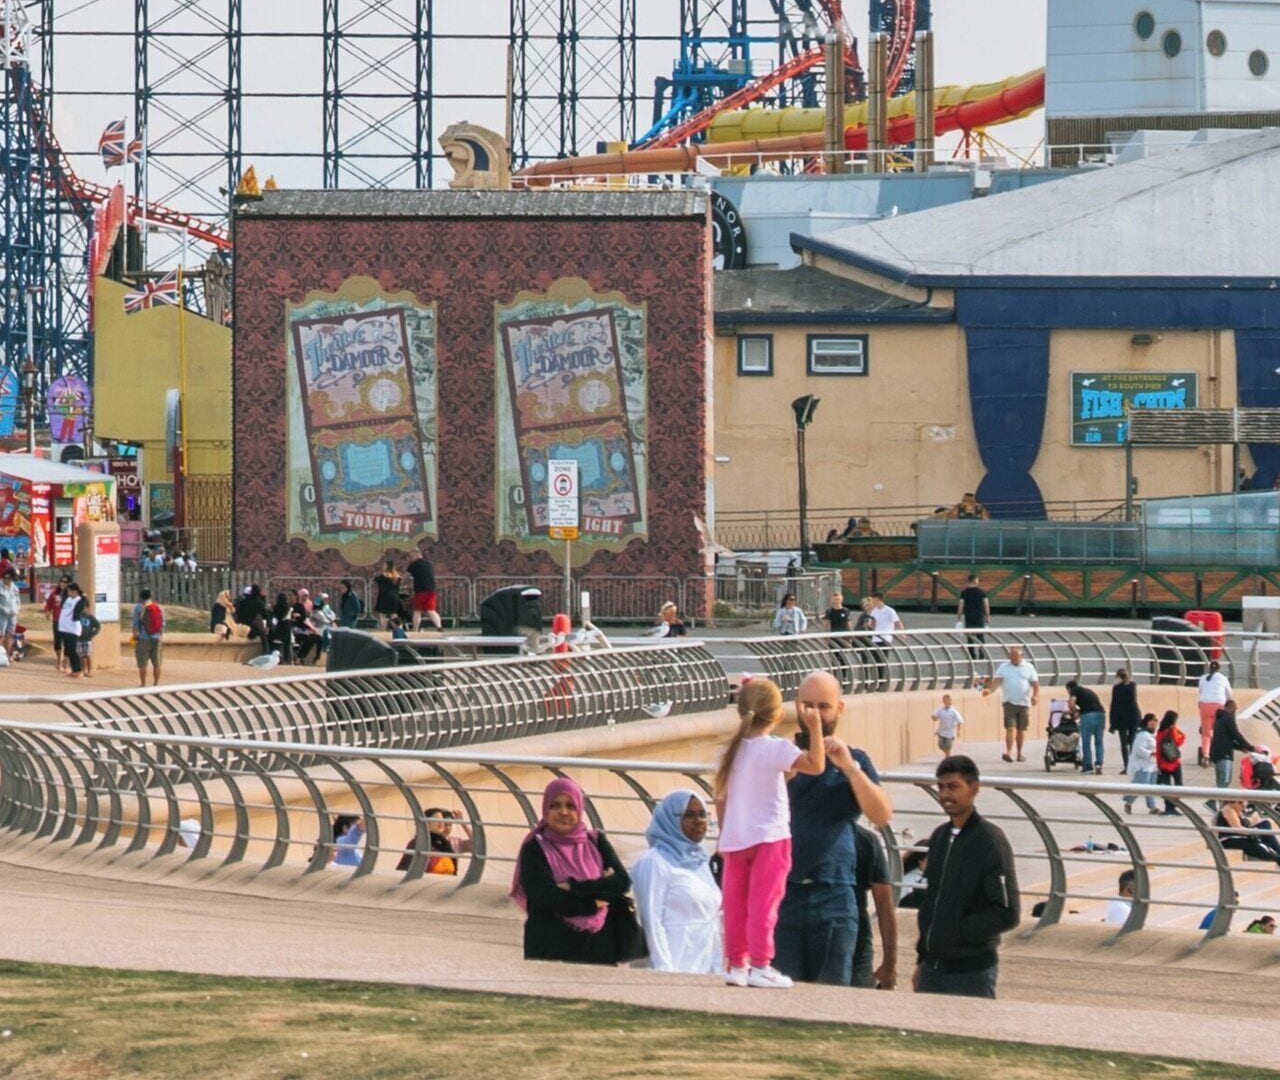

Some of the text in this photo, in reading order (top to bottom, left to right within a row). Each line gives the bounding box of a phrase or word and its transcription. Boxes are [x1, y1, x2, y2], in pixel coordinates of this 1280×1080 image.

[1081, 389, 1123, 419] FISH
[344, 512, 413, 533] TONIGHT
[585, 517, 624, 534] IGHT
